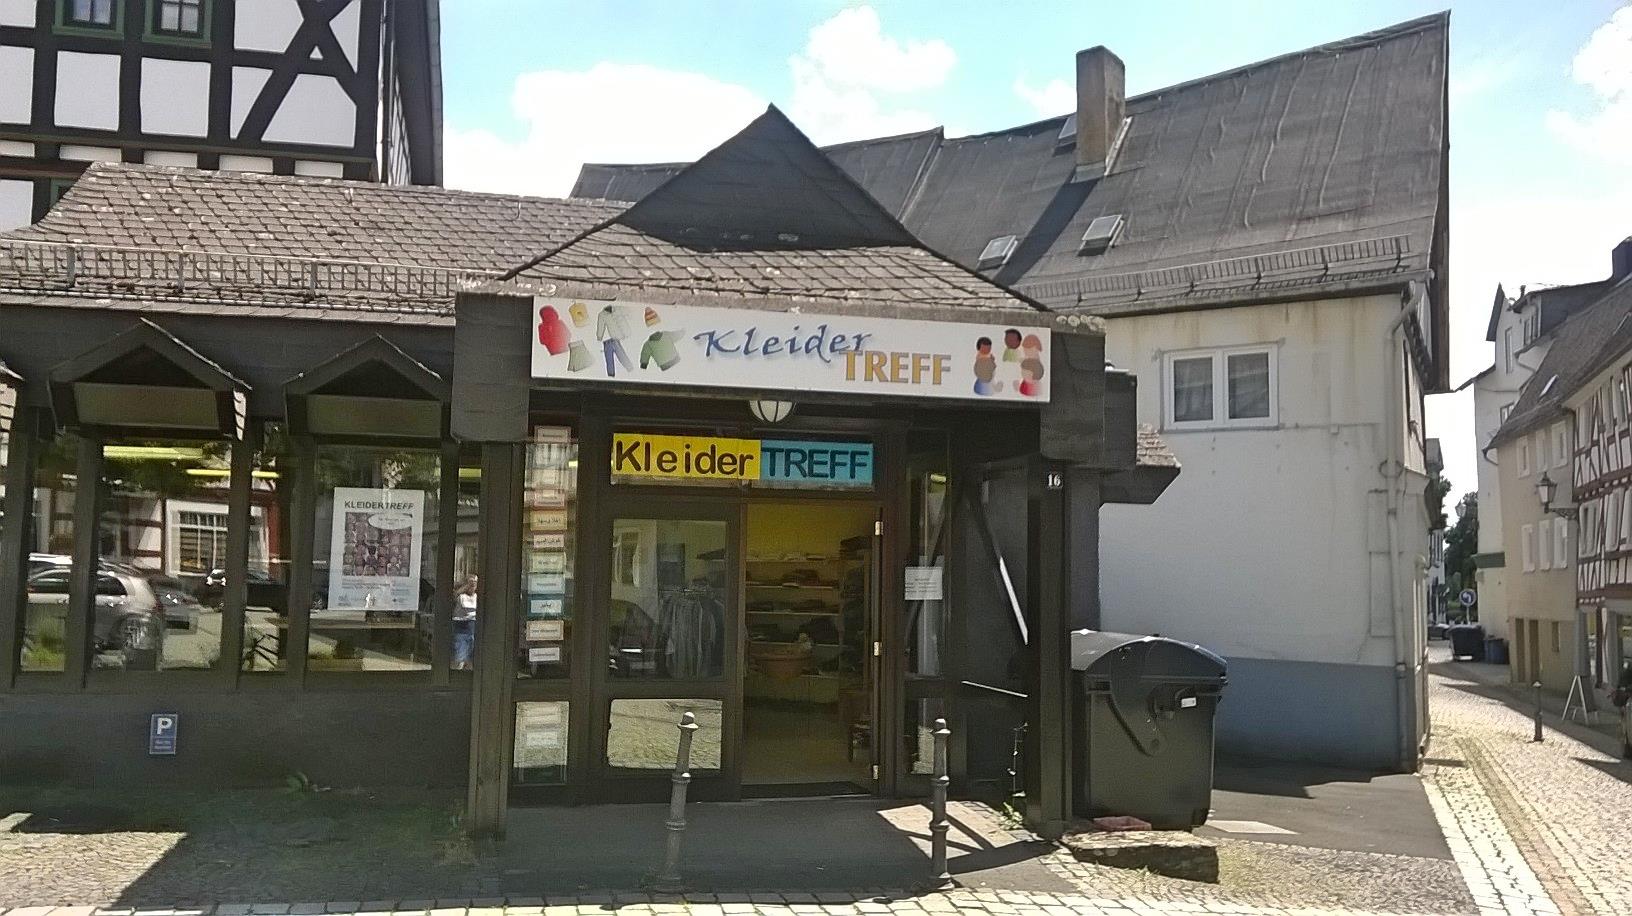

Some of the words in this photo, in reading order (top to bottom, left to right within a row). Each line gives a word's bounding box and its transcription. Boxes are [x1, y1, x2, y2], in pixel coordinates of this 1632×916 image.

[693, 325, 872, 363] Kleider
[839, 349, 952, 386] TREFF
[615, 440, 754, 476] Kleider
[761, 447, 870, 479] TREFF
[1048, 473, 1061, 487] 16
[156, 717, 173, 735] P
